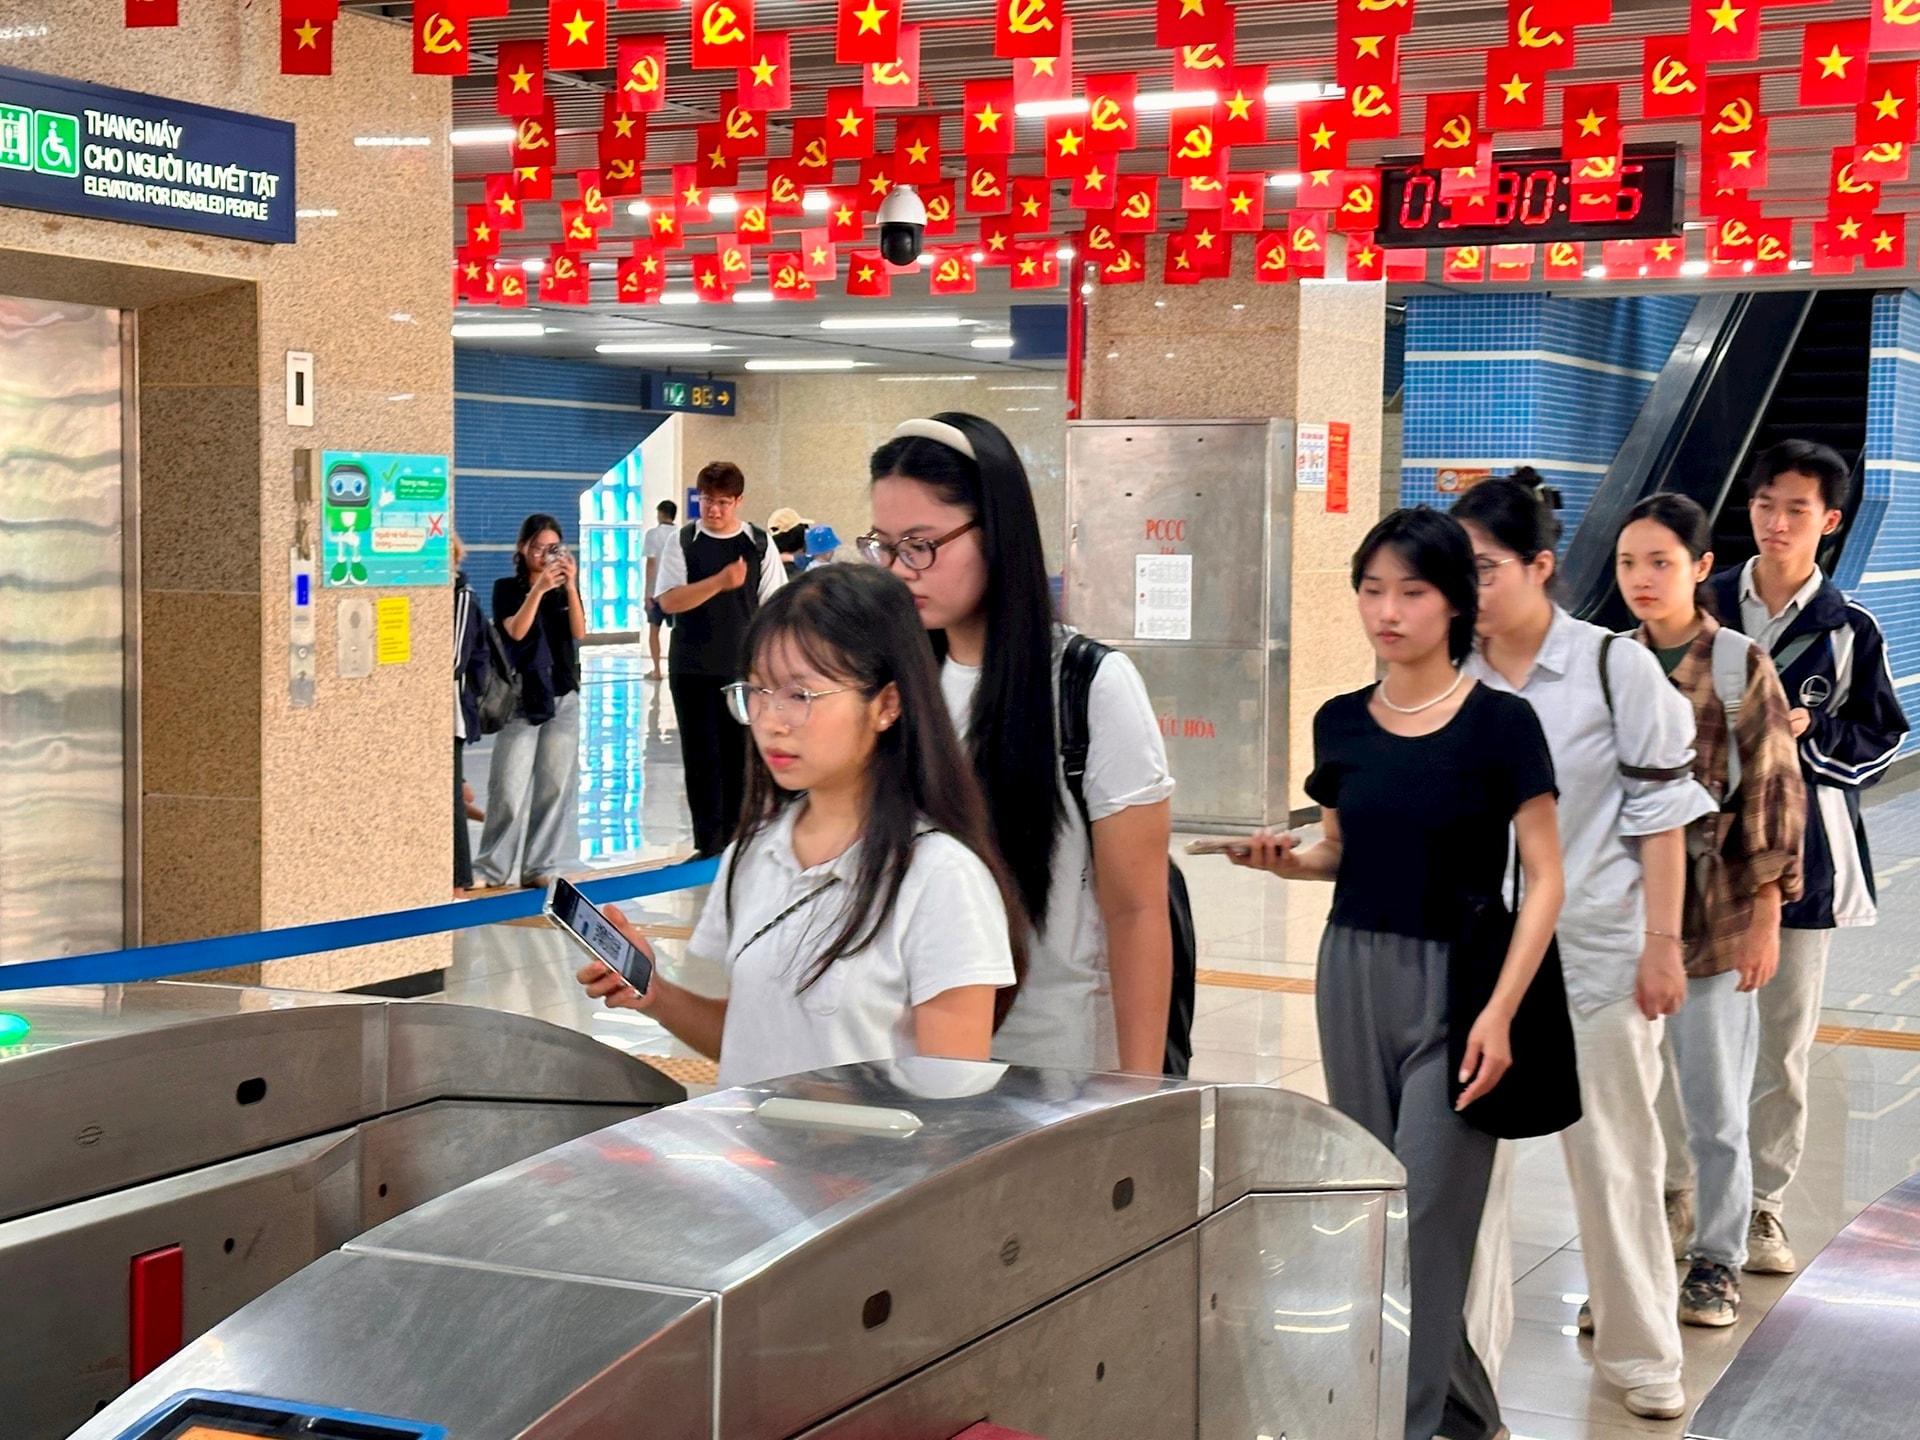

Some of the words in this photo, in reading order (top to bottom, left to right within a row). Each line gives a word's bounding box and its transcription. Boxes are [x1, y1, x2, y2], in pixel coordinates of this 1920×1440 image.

[84, 109, 144, 143] THANG
[145, 119, 182, 149] MÁY
[84, 144, 124, 173] CHO
[126, 152, 183, 183] NGƯỜI
[185, 163, 248, 193] KHUYẾT
[249, 171, 280, 201] TẬT
[84, 175, 145, 202] ELEVATOR
[145, 185, 171, 206] FOR
[171, 188, 226, 214] DISABLED
[225, 197, 269, 221] PEOPLE
[1145, 518, 1187, 541] PCCC
